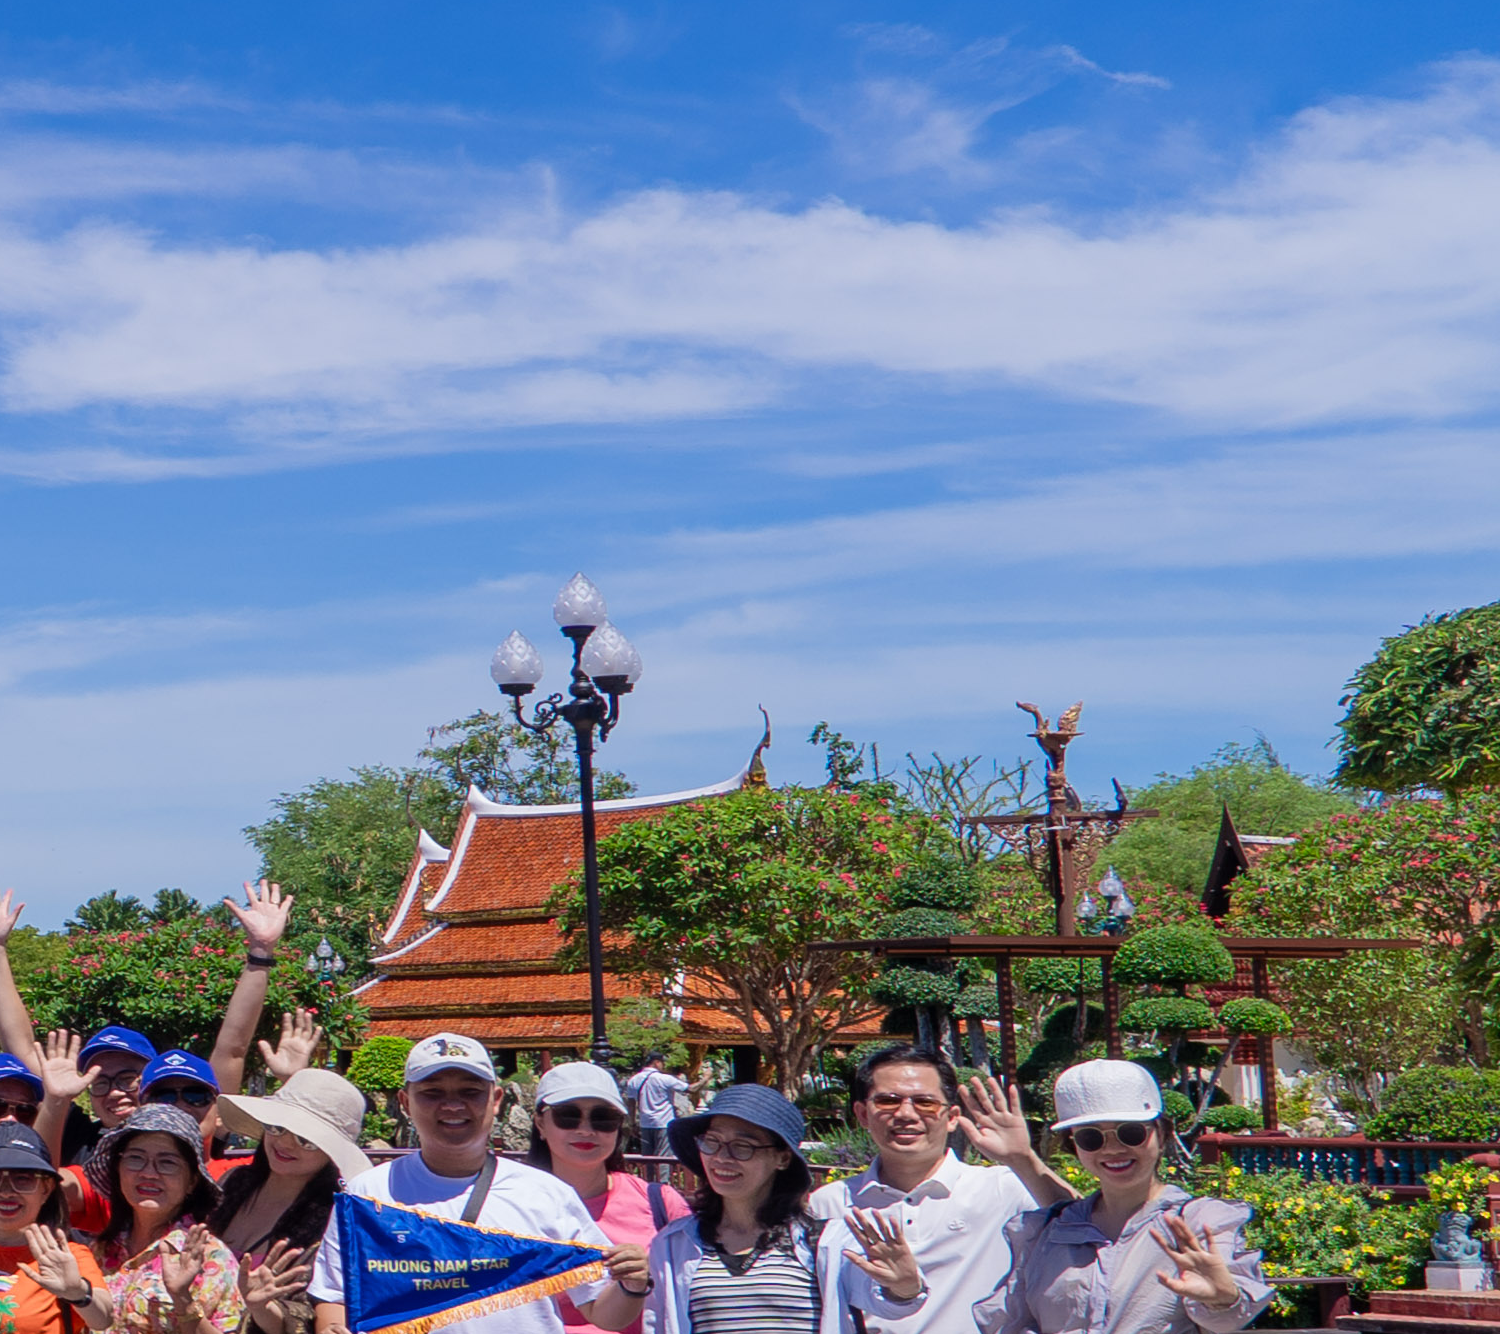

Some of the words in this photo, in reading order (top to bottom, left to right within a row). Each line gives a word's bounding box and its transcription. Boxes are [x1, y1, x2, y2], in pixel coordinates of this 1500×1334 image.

[367, 1259, 431, 1274] PHUONG
[434, 1259, 468, 1273] NAM
[471, 1258, 509, 1271] STAR
[412, 1277, 470, 1290] TRAVEL
